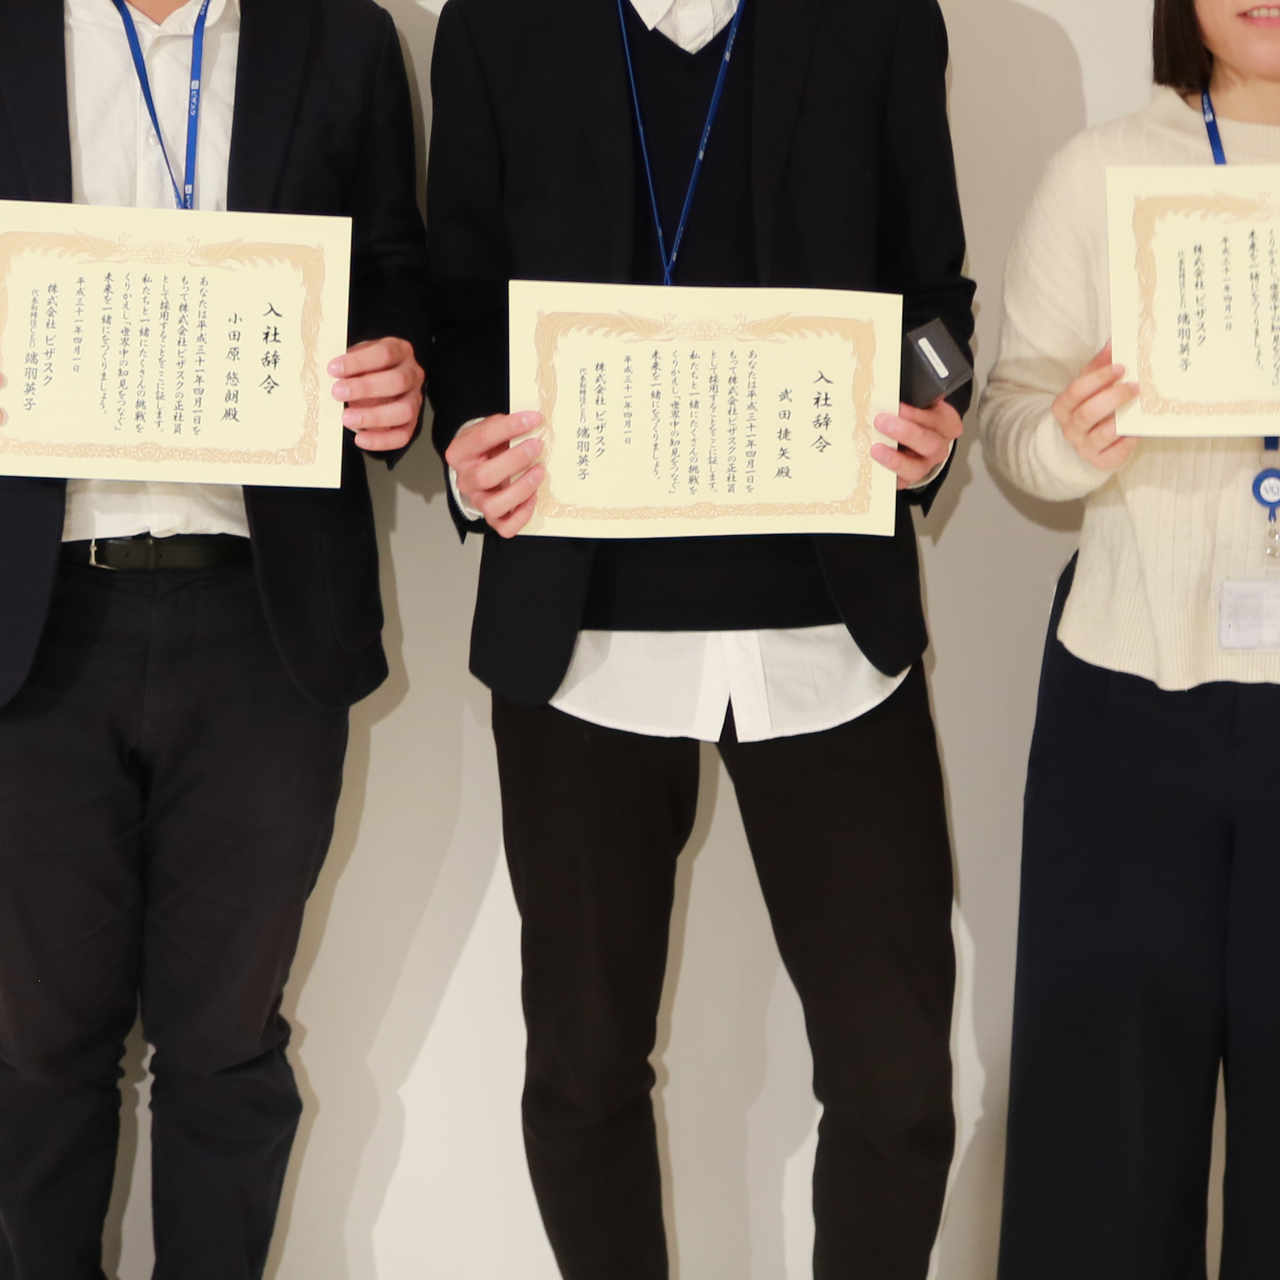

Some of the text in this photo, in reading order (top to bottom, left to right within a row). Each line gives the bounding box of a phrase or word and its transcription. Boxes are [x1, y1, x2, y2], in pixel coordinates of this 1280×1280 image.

[190, 90, 198, 116] ビザスク
[42, 282, 58, 387] 株式会社 ビザスク
[72, 276, 86, 373] 平成三十一年四月一日
[134, 273, 153, 434] 私たちと一緒にたくさんの挑戦を
[173, 275, 190, 435] もって株式会社ビザスクの正社員
[192, 276, 209, 436] あなたは平成三十一年四月一日を
[220, 312, 243, 423] 小田原 悠朗殿
[258, 302, 283, 395] 入社辞令
[23, 351, 39, 411] 端羽英子
[594, 361, 607, 459] 株式会社 ビザスク
[623, 355, 633, 445] 平成三十一年四月一日
[687, 350, 701, 495] 私たちと一緒にたくさんの挑戦を
[726, 350, 739, 494] もって株式会社ビザスクの正社員
[745, 349, 758, 493] あなたは平成三十一年四月一日を
[810, 370, 834, 453] 入社辞令
[773, 388, 793, 480] 武田捷矢殿
